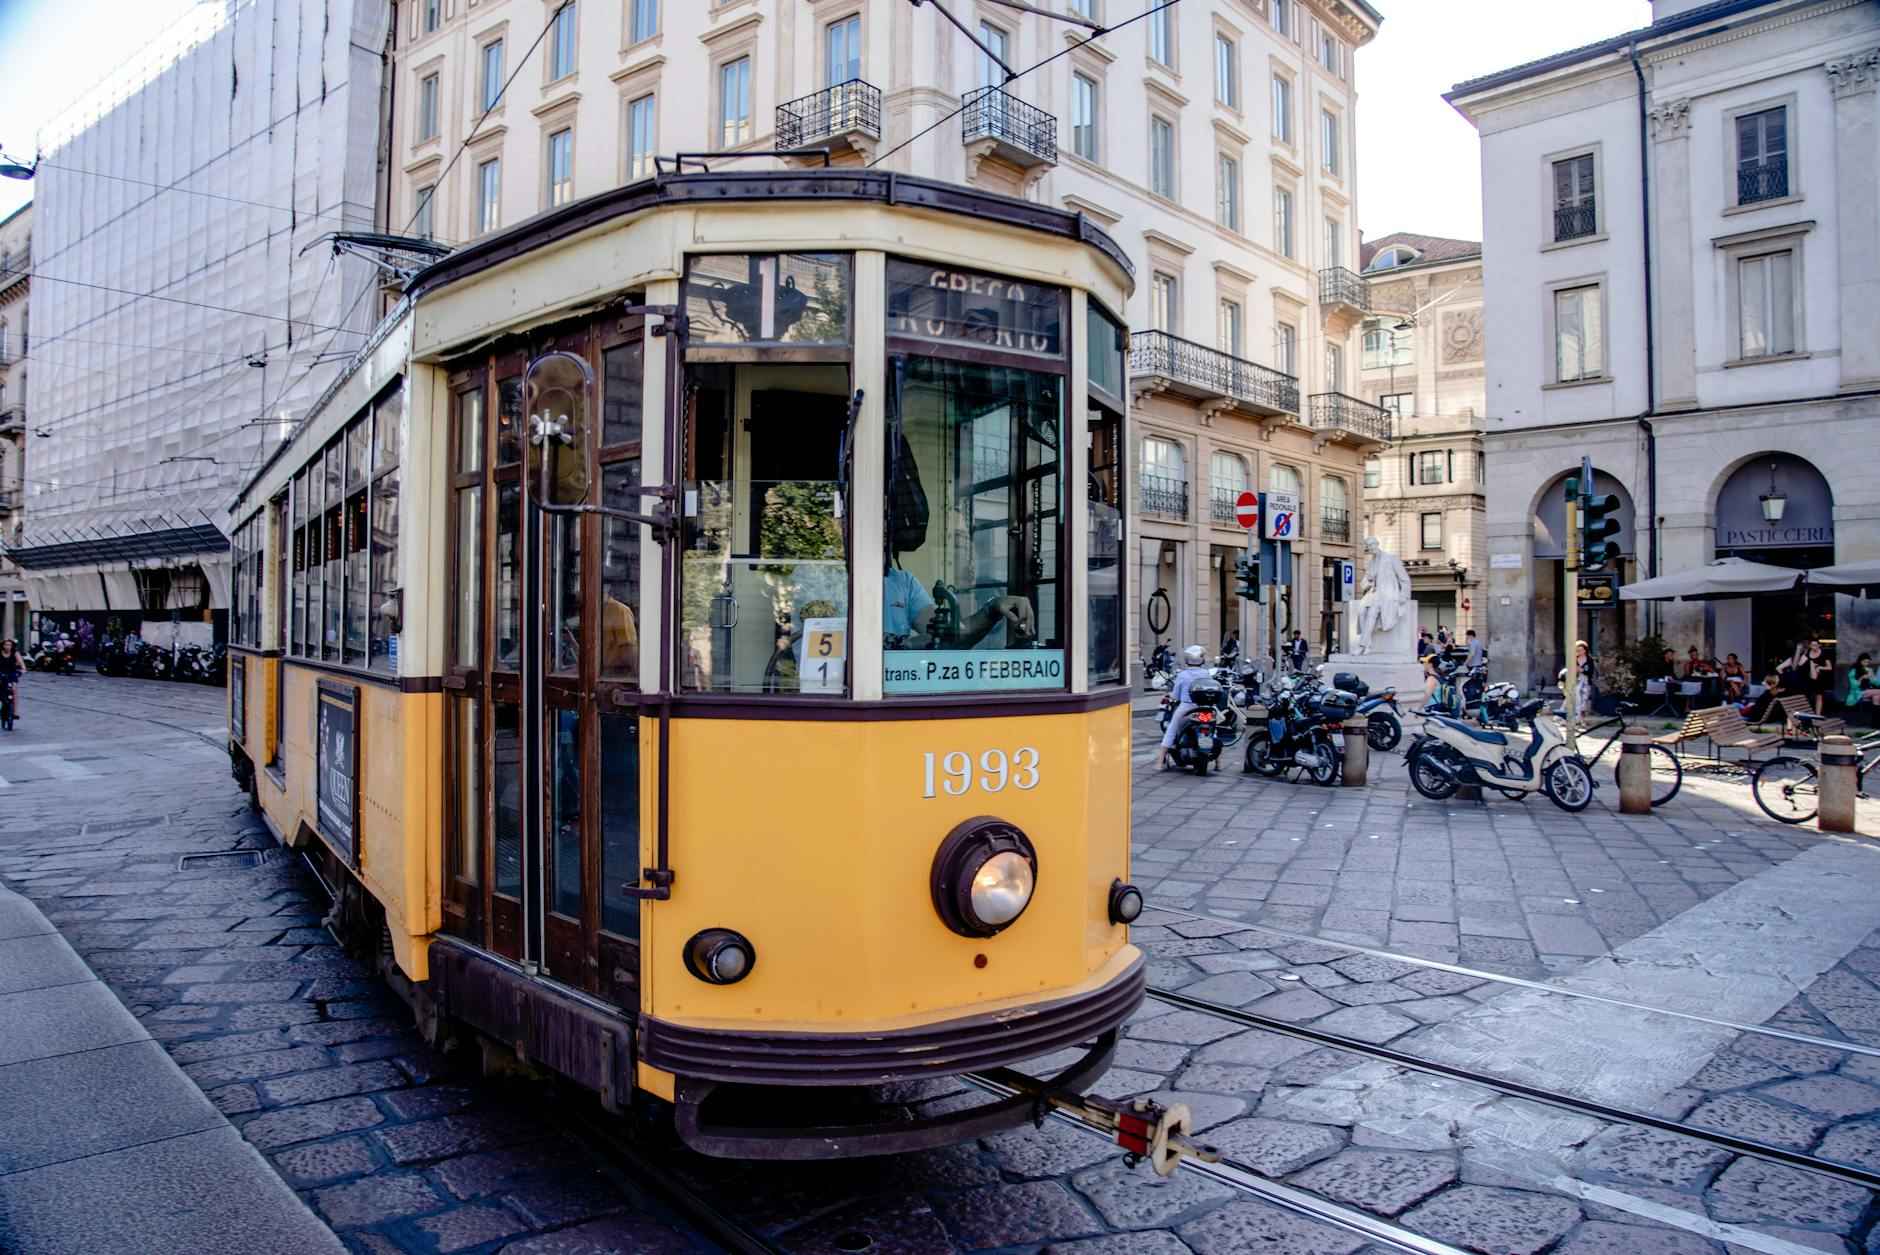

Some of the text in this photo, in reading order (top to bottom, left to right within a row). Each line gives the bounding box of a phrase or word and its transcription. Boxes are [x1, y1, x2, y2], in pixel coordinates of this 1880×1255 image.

[760, 257, 777, 338] 1
[818, 632, 833, 657] 5
[818, 662, 828, 687] 1
[885, 660, 1060, 681] trans. P.za 6 FEBBRAIO
[923, 746, 1041, 799] 1993
